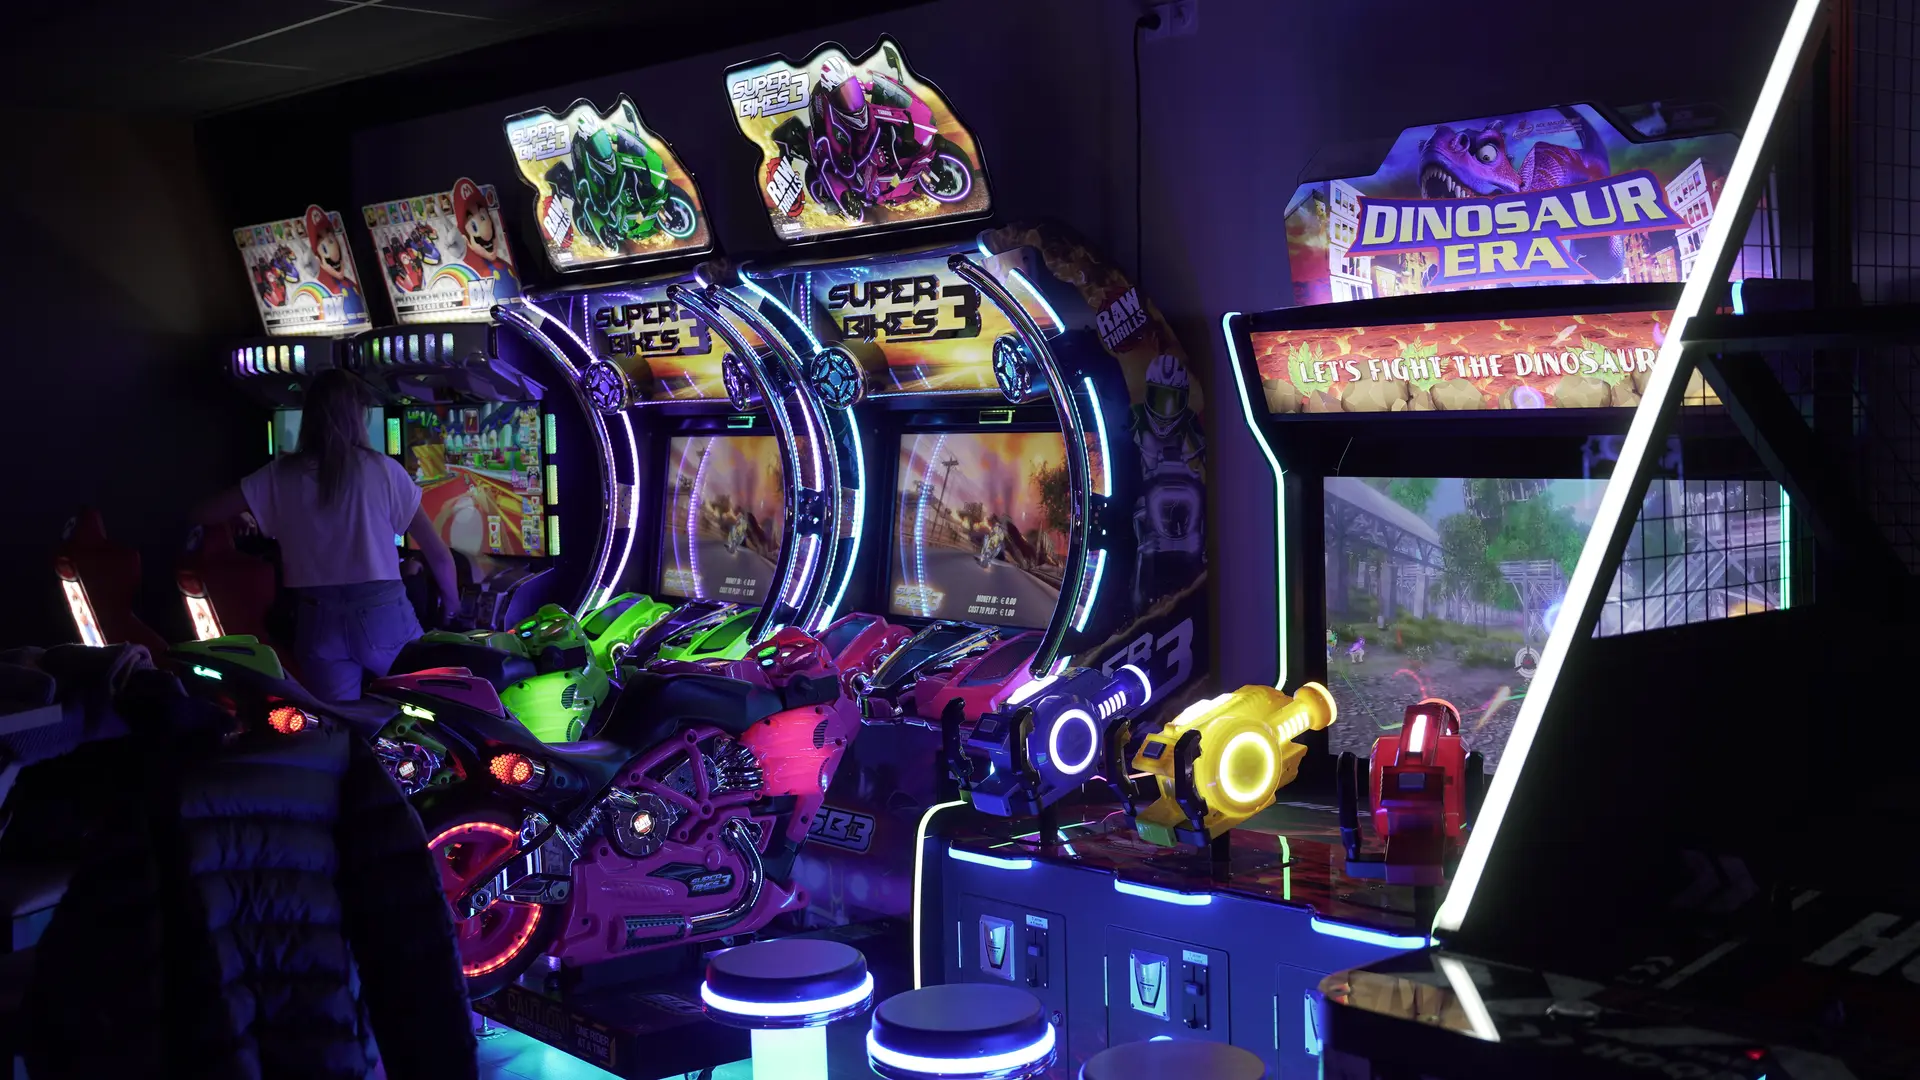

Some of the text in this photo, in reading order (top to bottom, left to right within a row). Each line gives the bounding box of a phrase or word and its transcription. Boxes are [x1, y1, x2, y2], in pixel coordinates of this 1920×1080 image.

[733, 69, 791, 99] SUPER
[740, 91, 790, 120] BIKES
[511, 121, 556, 145] SUPER
[519, 138, 556, 162] BIKES
[766, 156, 795, 206] RAW
[778, 175, 803, 216] THRILLS
[1361, 177, 1668, 245] DINOSAUR
[1444, 237, 1570, 278] ERA
[828, 274, 940, 309] SUPER
[596, 301, 678, 329] SUPER
[842, 308, 938, 343] BIKES
[1096, 286, 1141, 338] RAW
[608, 329, 680, 358] BIKES
[1103, 309, 1147, 351] THRILLS
[1299, 347, 1659, 384] LET'S FIGHT THE DINOSAUR
[968, 605, 979, 613] COST
[979, 606, 985, 614] TO
[985, 607, 998, 615] PLAY:
[1005, 609, 1015, 617] 1.00
[976, 594, 991, 603] MONEY
[1005, 597, 1017, 605] 0.00
[808, 809, 875, 852] SB3
[575, 1023, 609, 1047] ONE RIDER
[577, 1036, 586, 1048] AT
